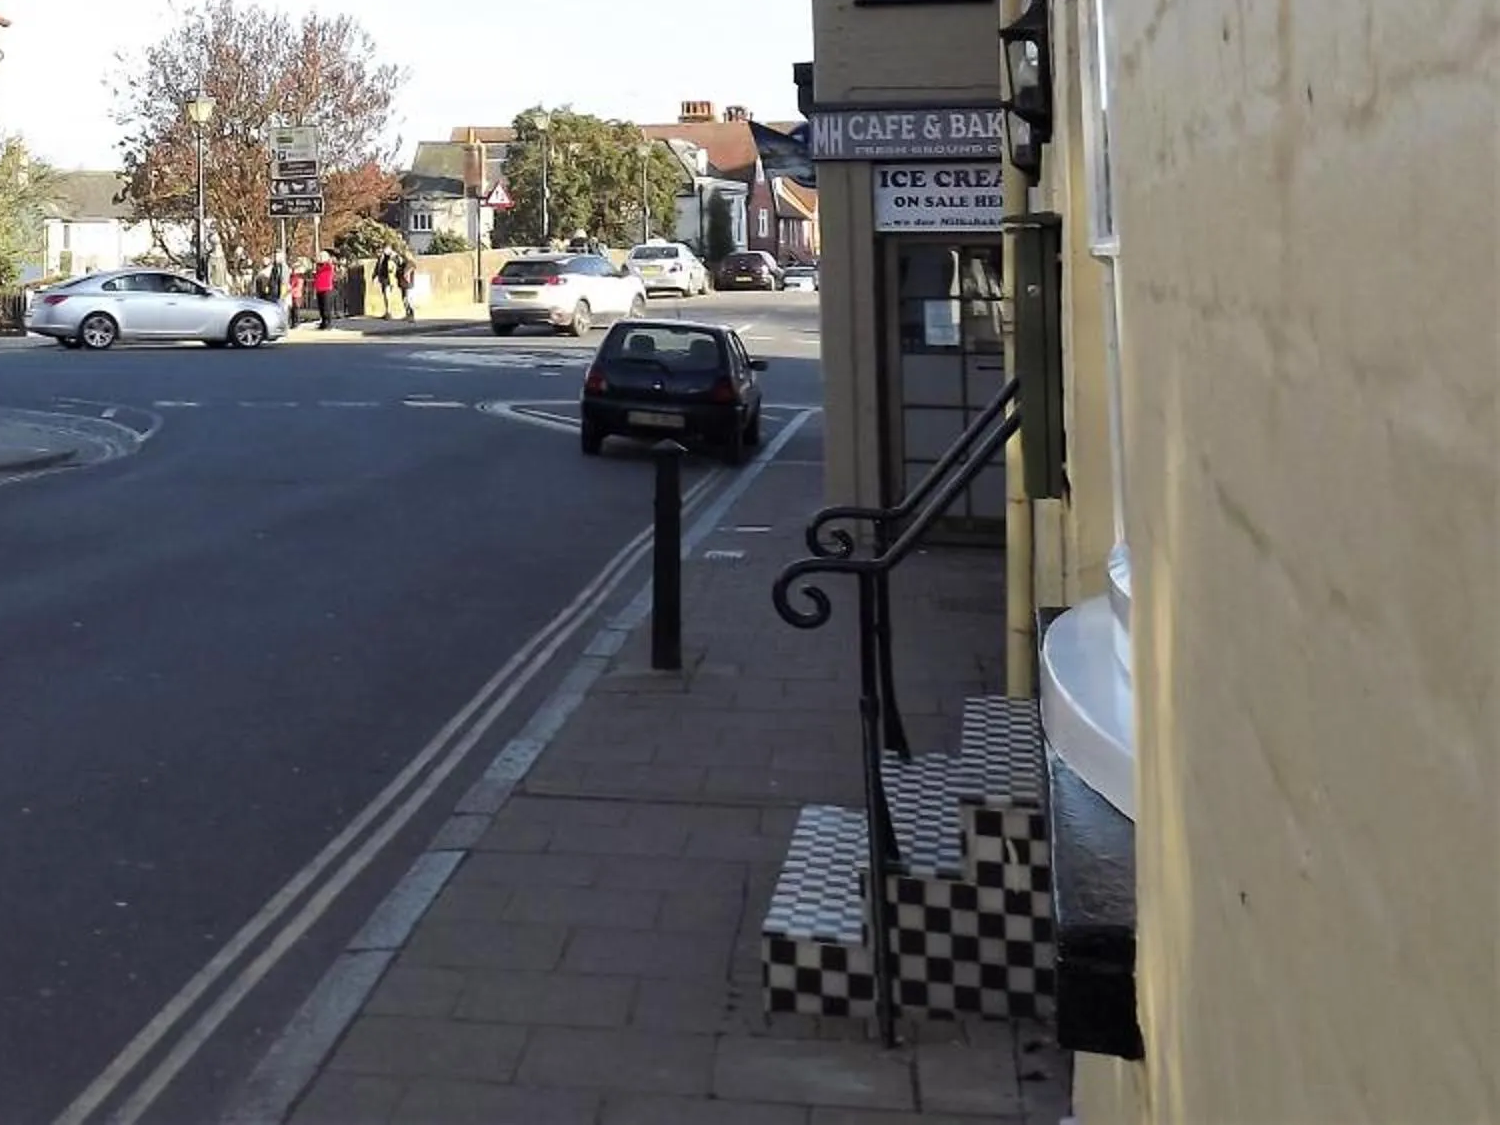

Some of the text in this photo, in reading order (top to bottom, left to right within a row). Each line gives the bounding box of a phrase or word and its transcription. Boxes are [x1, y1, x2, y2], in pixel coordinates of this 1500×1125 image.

[847, 114, 916, 140] CAFE
[923, 114, 942, 139] &
[911, 145, 983, 154] GROUND
[880, 170, 927, 188] ICE
[893, 196, 919, 208] ON
[924, 196, 969, 208] SALE
